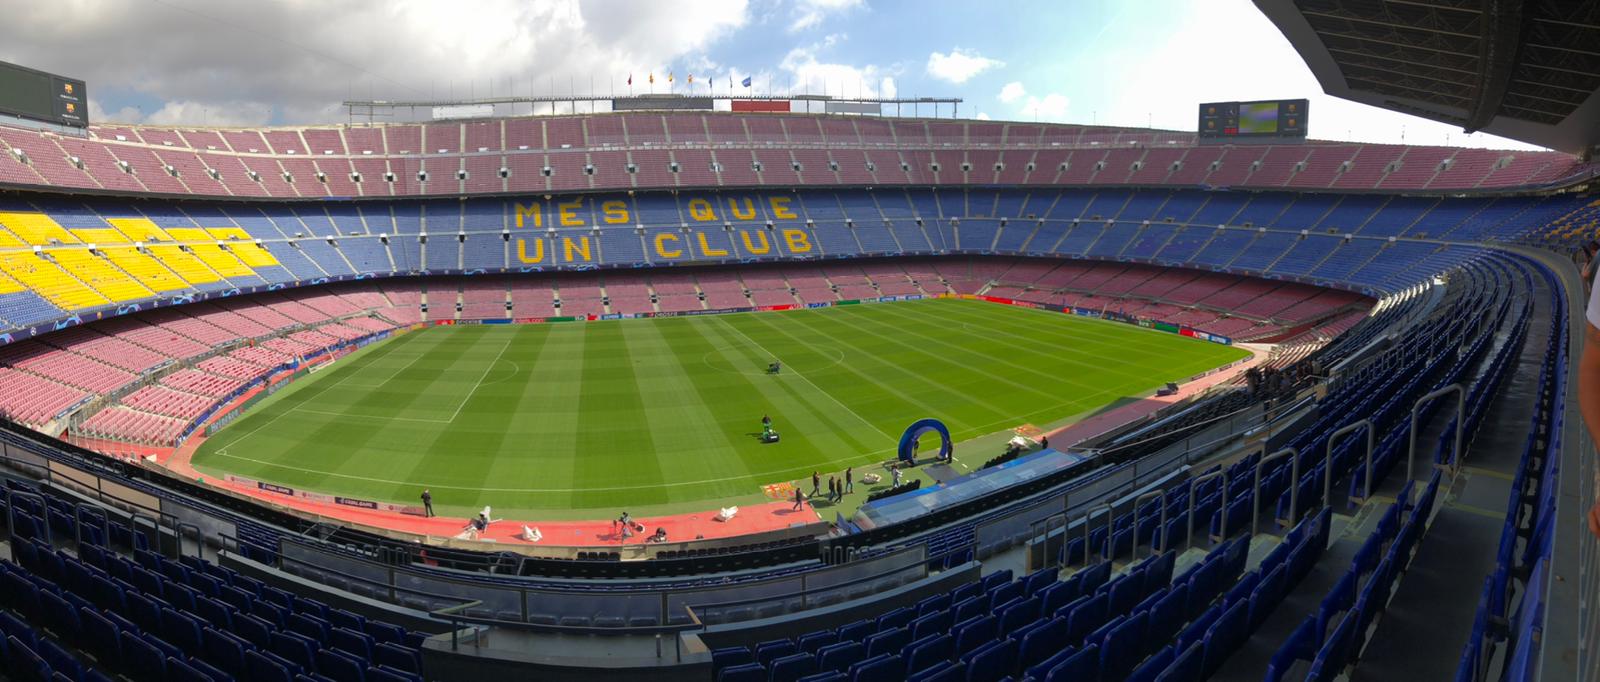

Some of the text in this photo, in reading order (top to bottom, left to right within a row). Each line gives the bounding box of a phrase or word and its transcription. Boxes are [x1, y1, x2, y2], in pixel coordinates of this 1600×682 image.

[515, 195, 798, 228] MÉS QUE
[516, 229, 813, 264] UN CLUB
